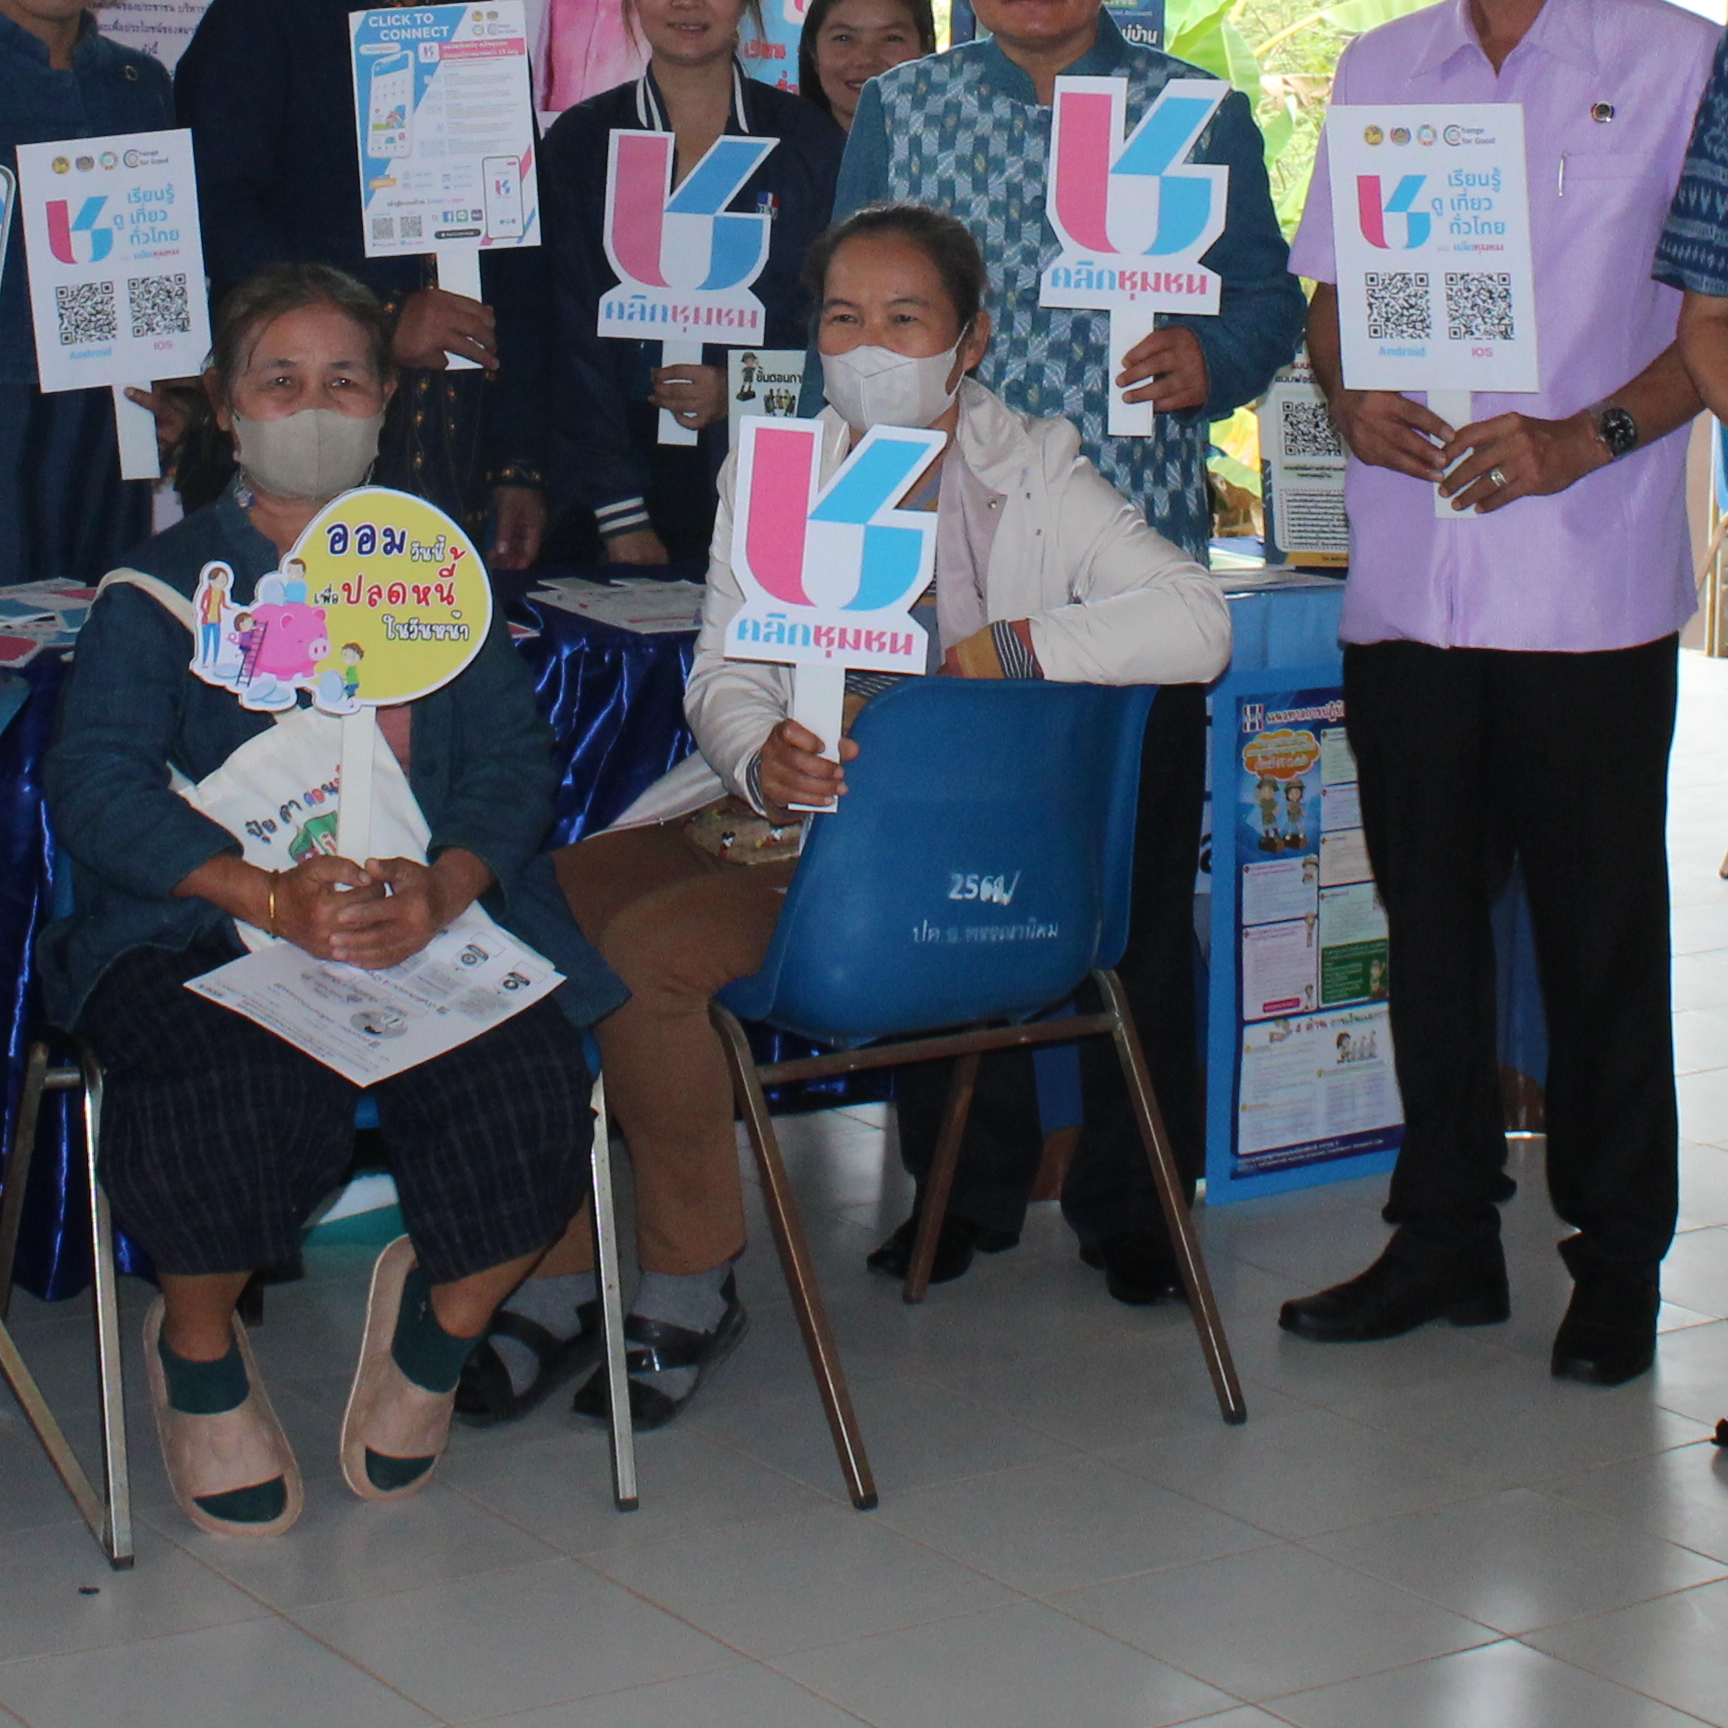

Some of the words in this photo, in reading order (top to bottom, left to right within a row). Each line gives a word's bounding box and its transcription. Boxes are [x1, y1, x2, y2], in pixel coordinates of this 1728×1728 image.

[369, 13, 410, 28] CLICK
[414, 11, 436, 26] TO
[380, 25, 451, 41] CONNECT
[1448, 167, 1502, 193] เรียนรู้
[127, 183, 175, 204] เรียนรู้
[1431, 198, 1444, 217] ดู
[1451, 188, 1493, 212] เที่ยว
[114, 214, 125, 230] ดู
[130, 204, 168, 225] เที่ยว
[1450, 216, 1506, 236] ทั่วไทย
[130, 226, 180, 246] ทั่วไทย
[1050, 260, 1208, 302] คลิกชุมชน
[605, 294, 758, 334] คลิกชุมชน
[1378, 346, 1426, 358] Android
[326, 523, 407, 556] ออม
[411, 535, 446, 562] วันนี้
[314, 583, 339, 605] เพื่อ
[341, 546, 467, 607] ปลดหนี้
[382, 610, 470, 641] ในวันหน้า
[737, 612, 915, 659] คลิกชุมชน
